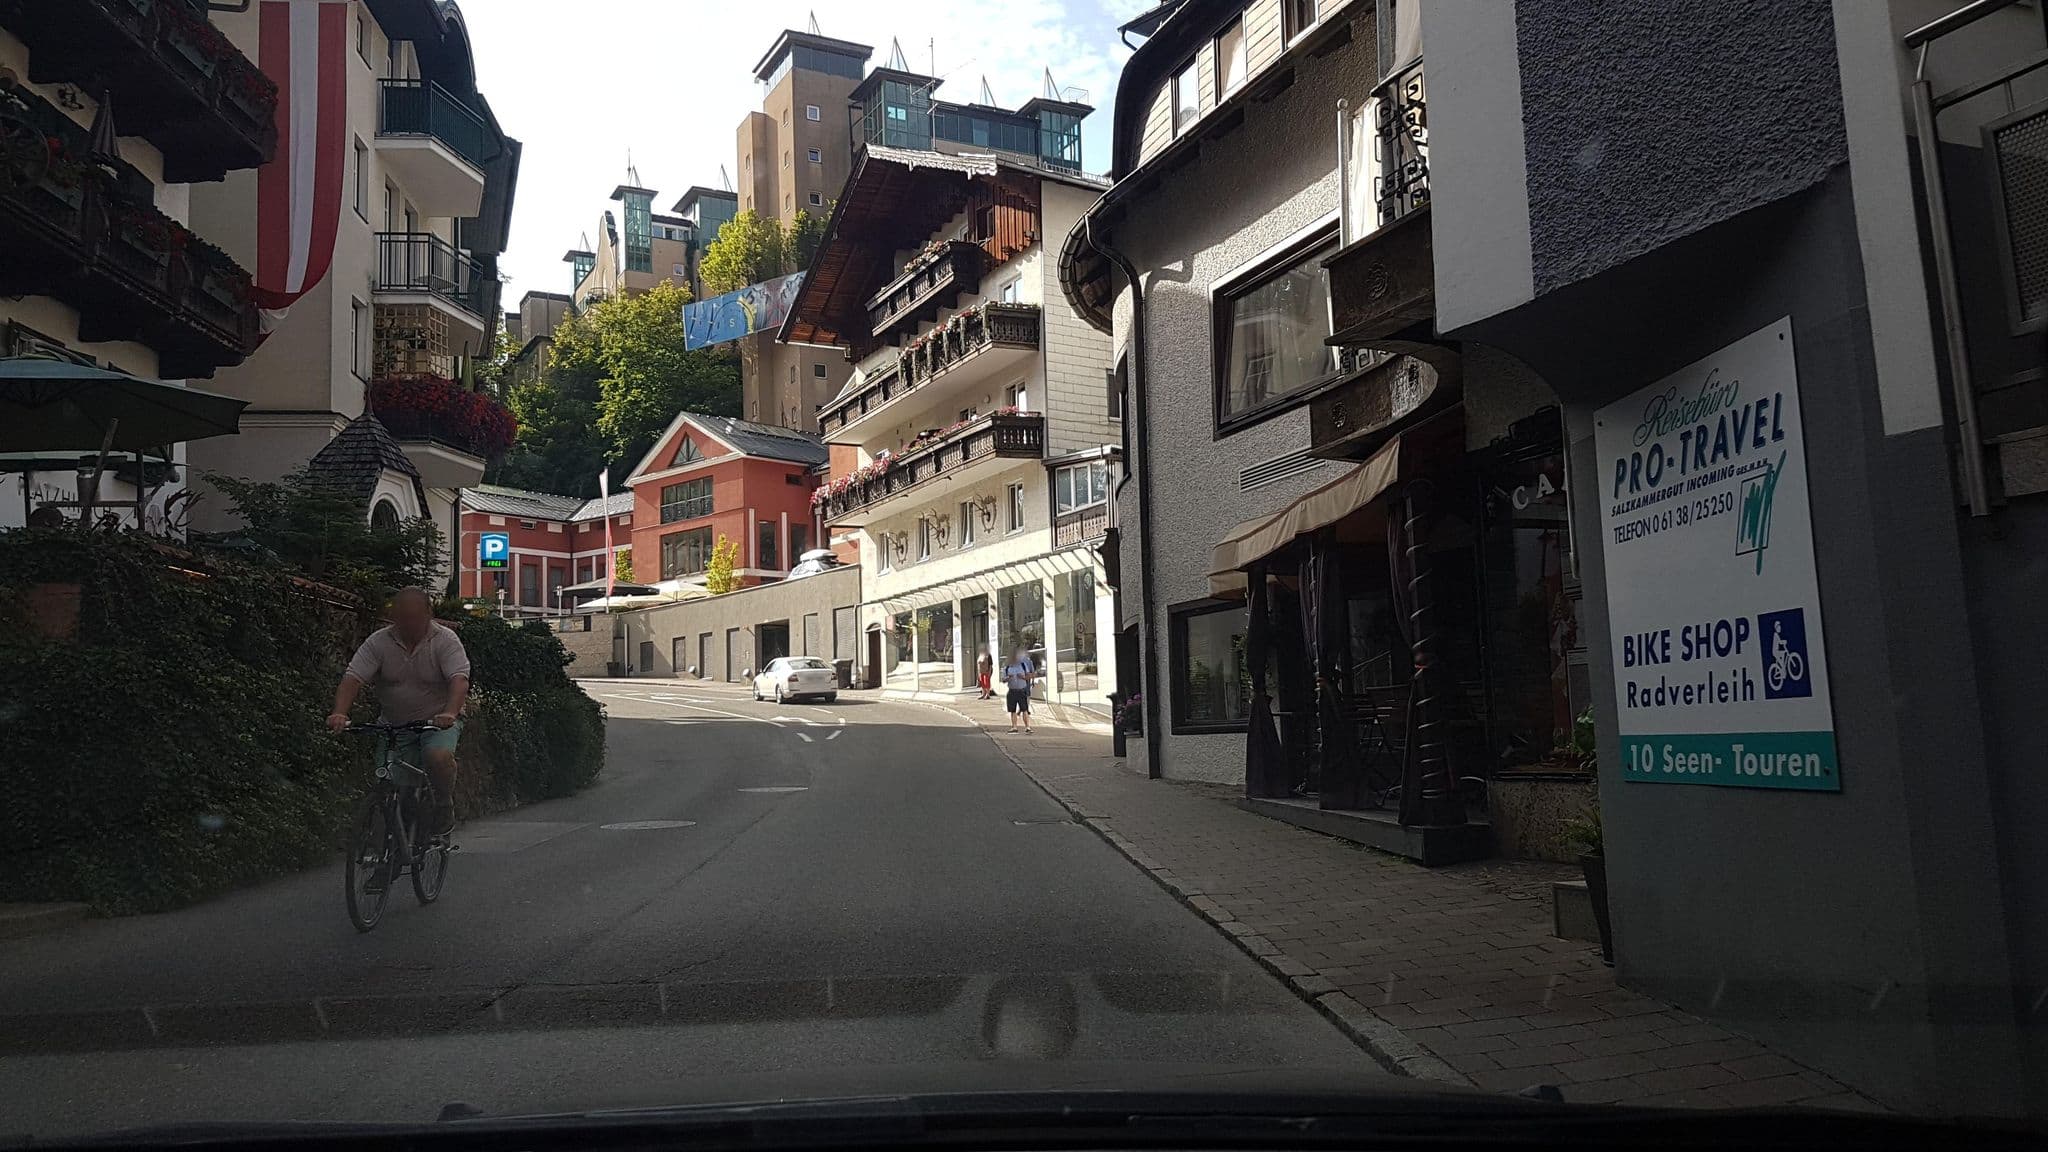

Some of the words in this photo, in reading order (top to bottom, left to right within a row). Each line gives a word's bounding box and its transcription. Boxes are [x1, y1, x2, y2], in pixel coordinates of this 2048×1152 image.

[1633, 368, 1739, 447] Reisebüro
[1512, 473, 1568, 510] CA
[1611, 482, 1684, 517] SALZKAMMERGUT
[1686, 464, 1735, 492] INCOMING
[485, 539, 504, 559] P
[1613, 517, 1651, 544] TELEFON
[1624, 629, 1671, 668] BIKE
[1681, 617, 1750, 662] SHOP
[1627, 667, 1755, 708] Radverleih
[1630, 744, 1654, 773] 10
[1732, 744, 1821, 777] Touren
